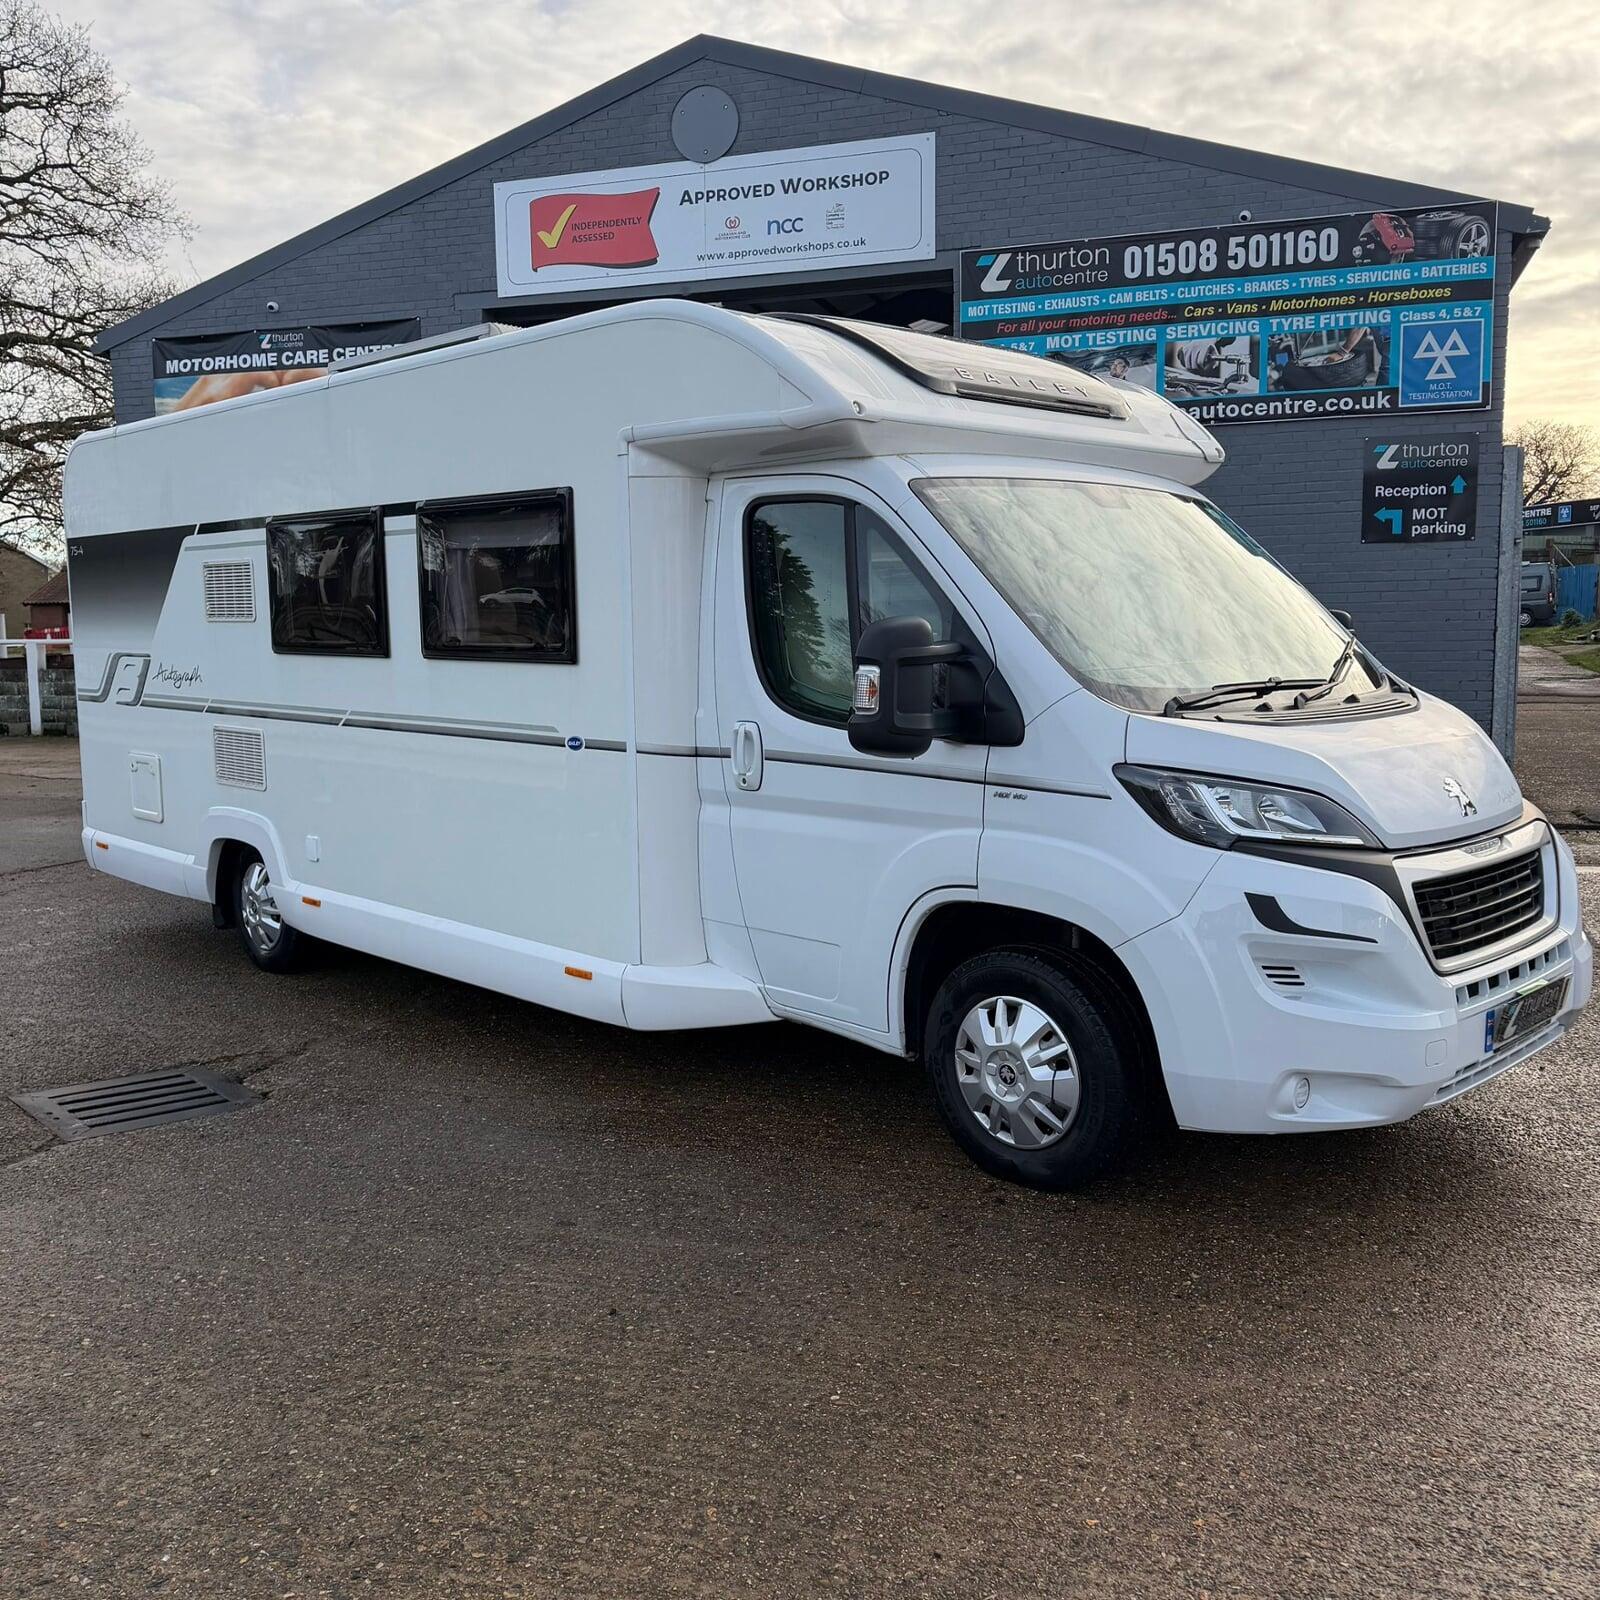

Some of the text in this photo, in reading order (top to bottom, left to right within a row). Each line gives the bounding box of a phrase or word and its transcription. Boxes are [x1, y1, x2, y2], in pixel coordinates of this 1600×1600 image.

[679, 170, 890, 206] APPROVED WORKSHOP
[571, 216, 642, 231] INDEPENDENTLY
[767, 217, 804, 235] ncc
[571, 231, 615, 243] ASSESSED
[696, 237, 867, 262] www.approvedworkshops.co.uk
[1016, 247, 1110, 273] thurton
[1123, 227, 1339, 279] 01508 501160
[968, 262, 1488, 317] MOT TESTING EXHAUSTS CAM BELTS CLUTCHES BRAKES TYRES SERVICING BATTERIES
[1014, 269, 1109, 290] autocentre
[1184, 286, 1452, 318] Cars Vans Motorhomes Horseboxes
[997, 308, 1177, 334] For all your motoring needs...
[1269, 309, 1392, 332] TYRE FITTING
[1400, 310, 1436, 322] Class
[1438, 308, 1451, 320] 4,
[271, 332, 304, 342] thurton
[1046, 327, 1157, 350] MOT TESTING
[1166, 319, 1260, 340] SERVICING
[271, 341, 304, 349] autocentre
[165, 353, 278, 374] MOTORHOME
[281, 349, 330, 366] CARE
[954, 366, 1090, 398] BAILEY
[1429, 382, 1453, 391] M.O.T.
[1181, 391, 1391, 419] autocentre.co.uk
[1408, 389, 1473, 400] TESTING STATION
[1402, 442, 1470, 458] thurton
[1400, 457, 1469, 469] autocentre
[1375, 483, 1447, 499] Reception
[1412, 507, 1448, 520] MOT
[1411, 522, 1467, 537] parking
[151, 662, 203, 689] Autograph
